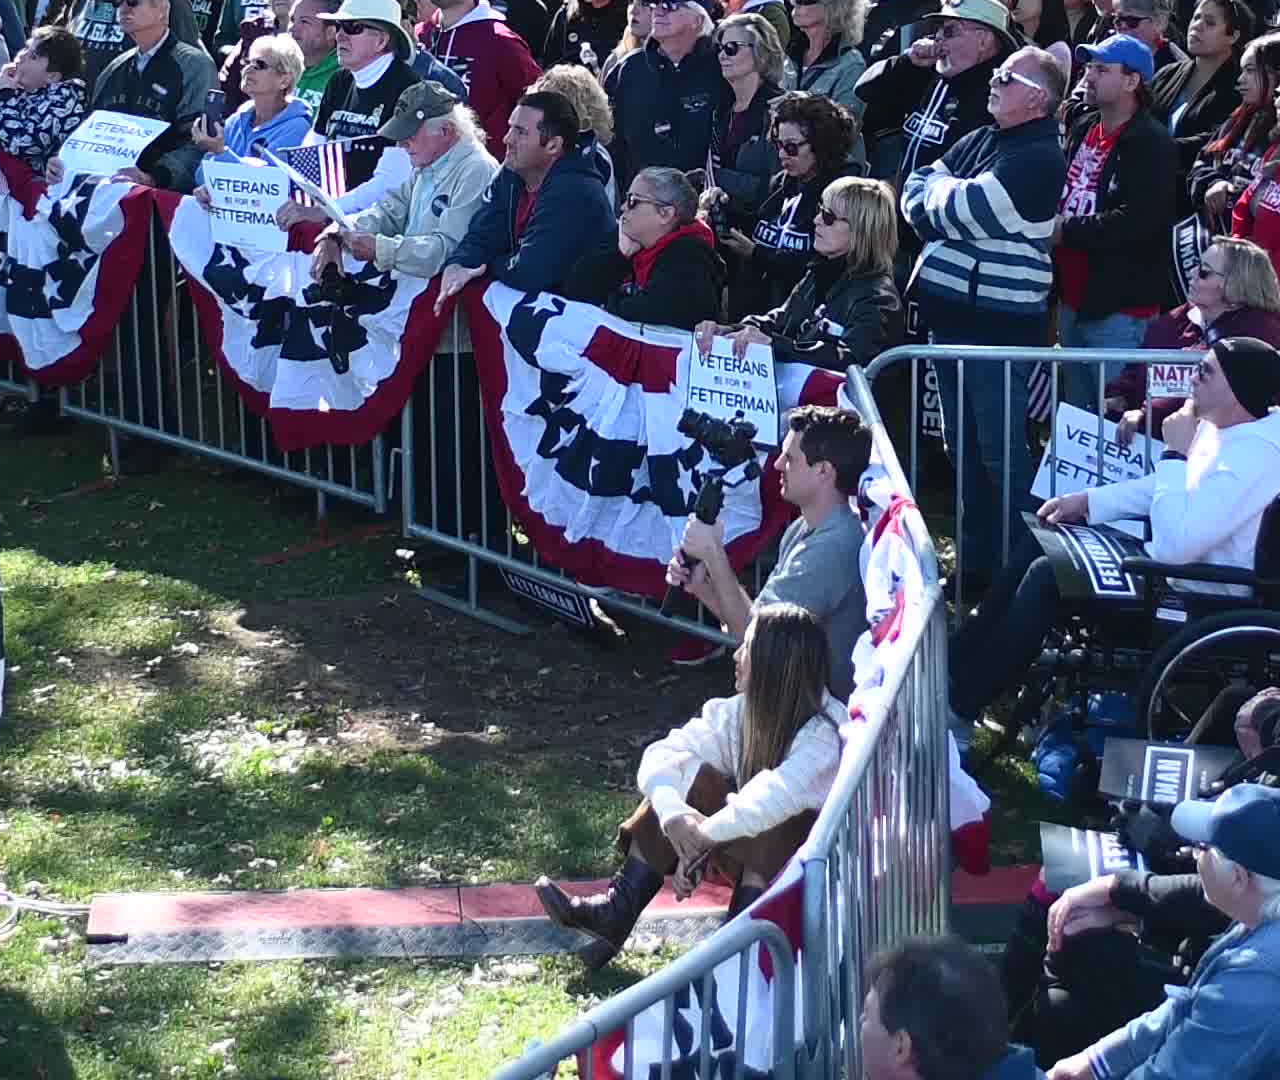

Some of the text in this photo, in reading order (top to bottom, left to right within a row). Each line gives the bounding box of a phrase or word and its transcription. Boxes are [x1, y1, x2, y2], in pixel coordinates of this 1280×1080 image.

[87, 122, 152, 139] VETERANS
[66, 140, 139, 159] FETTERMAN
[211, 180, 280, 196] VETERANS
[234, 197, 249, 208] FOR
[211, 208, 277, 226] FETTERMA
[699, 353, 768, 378] VETERANS
[726, 378, 740, 387] FOR
[690, 386, 775, 415] FETTERMAN
[506, 573, 576, 613] FETTERMAN
